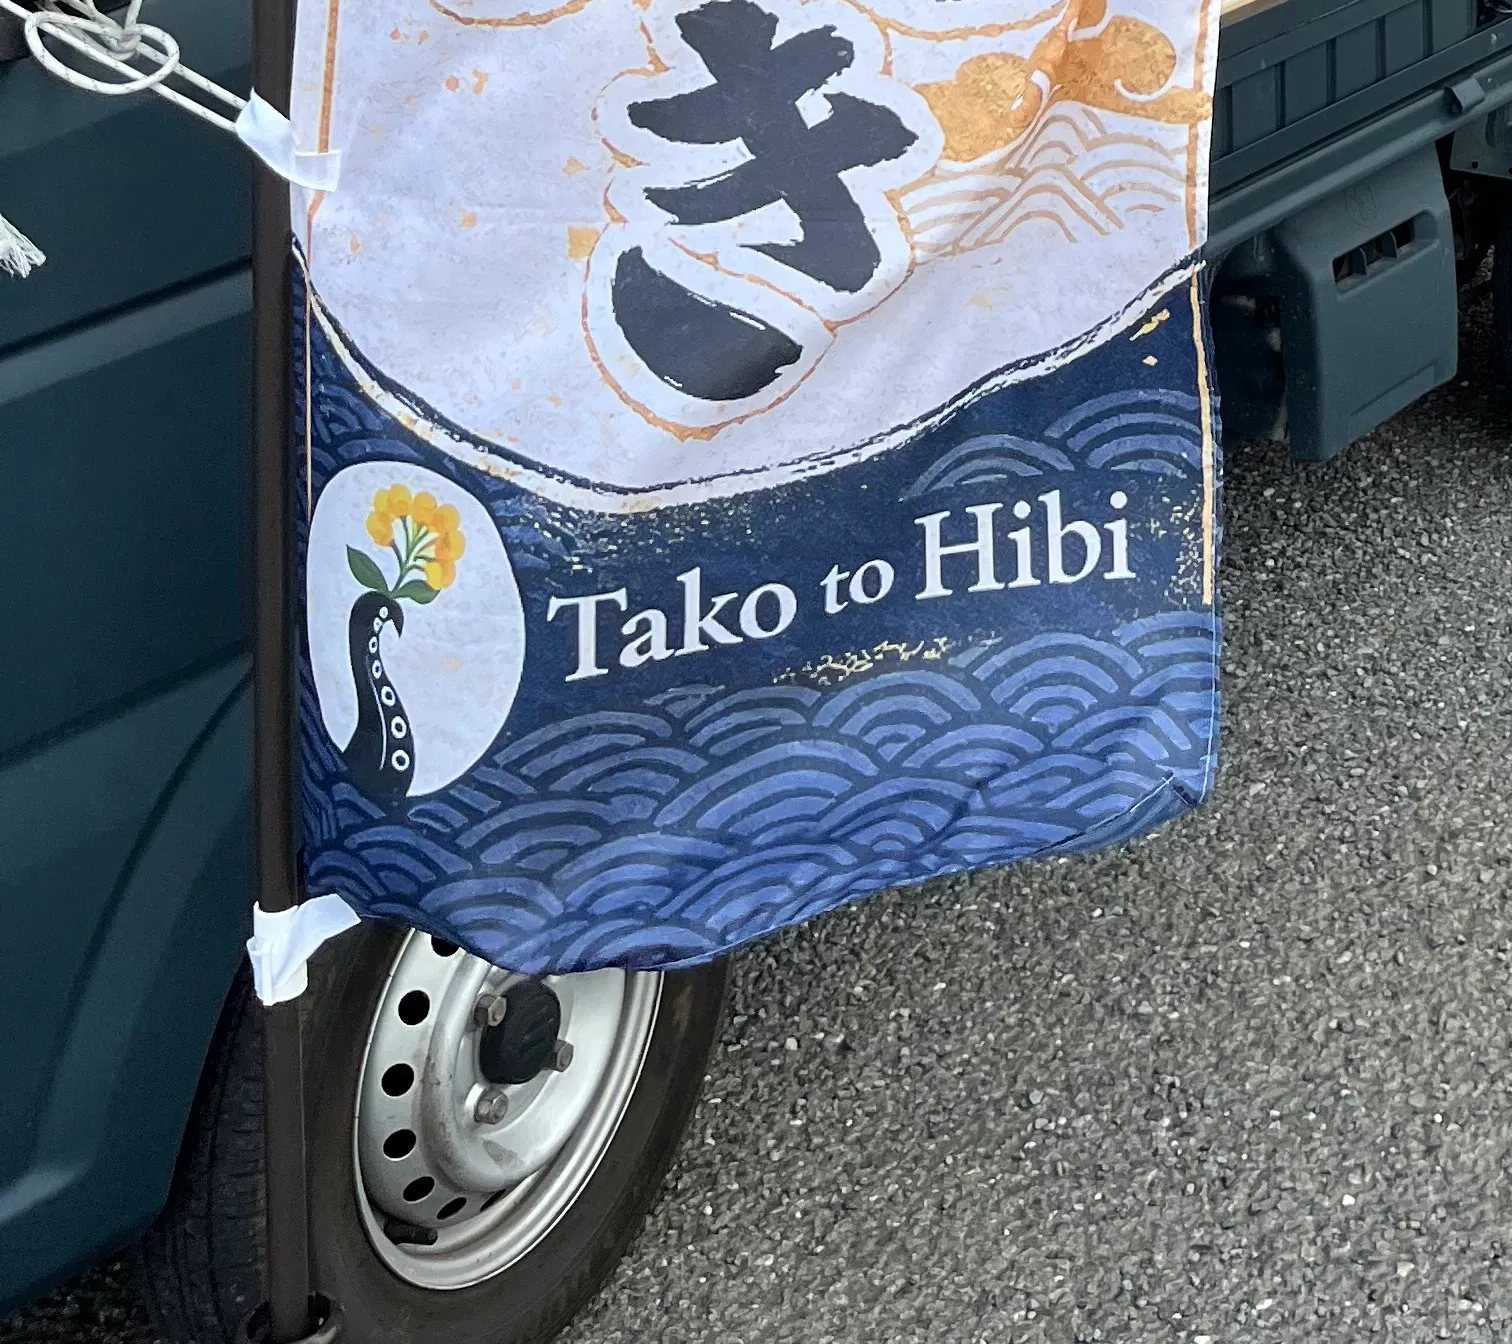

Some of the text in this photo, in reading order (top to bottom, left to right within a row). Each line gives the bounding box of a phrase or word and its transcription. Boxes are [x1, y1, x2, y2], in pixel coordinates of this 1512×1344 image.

[545, 489, 1139, 683] Tako to Hibi
